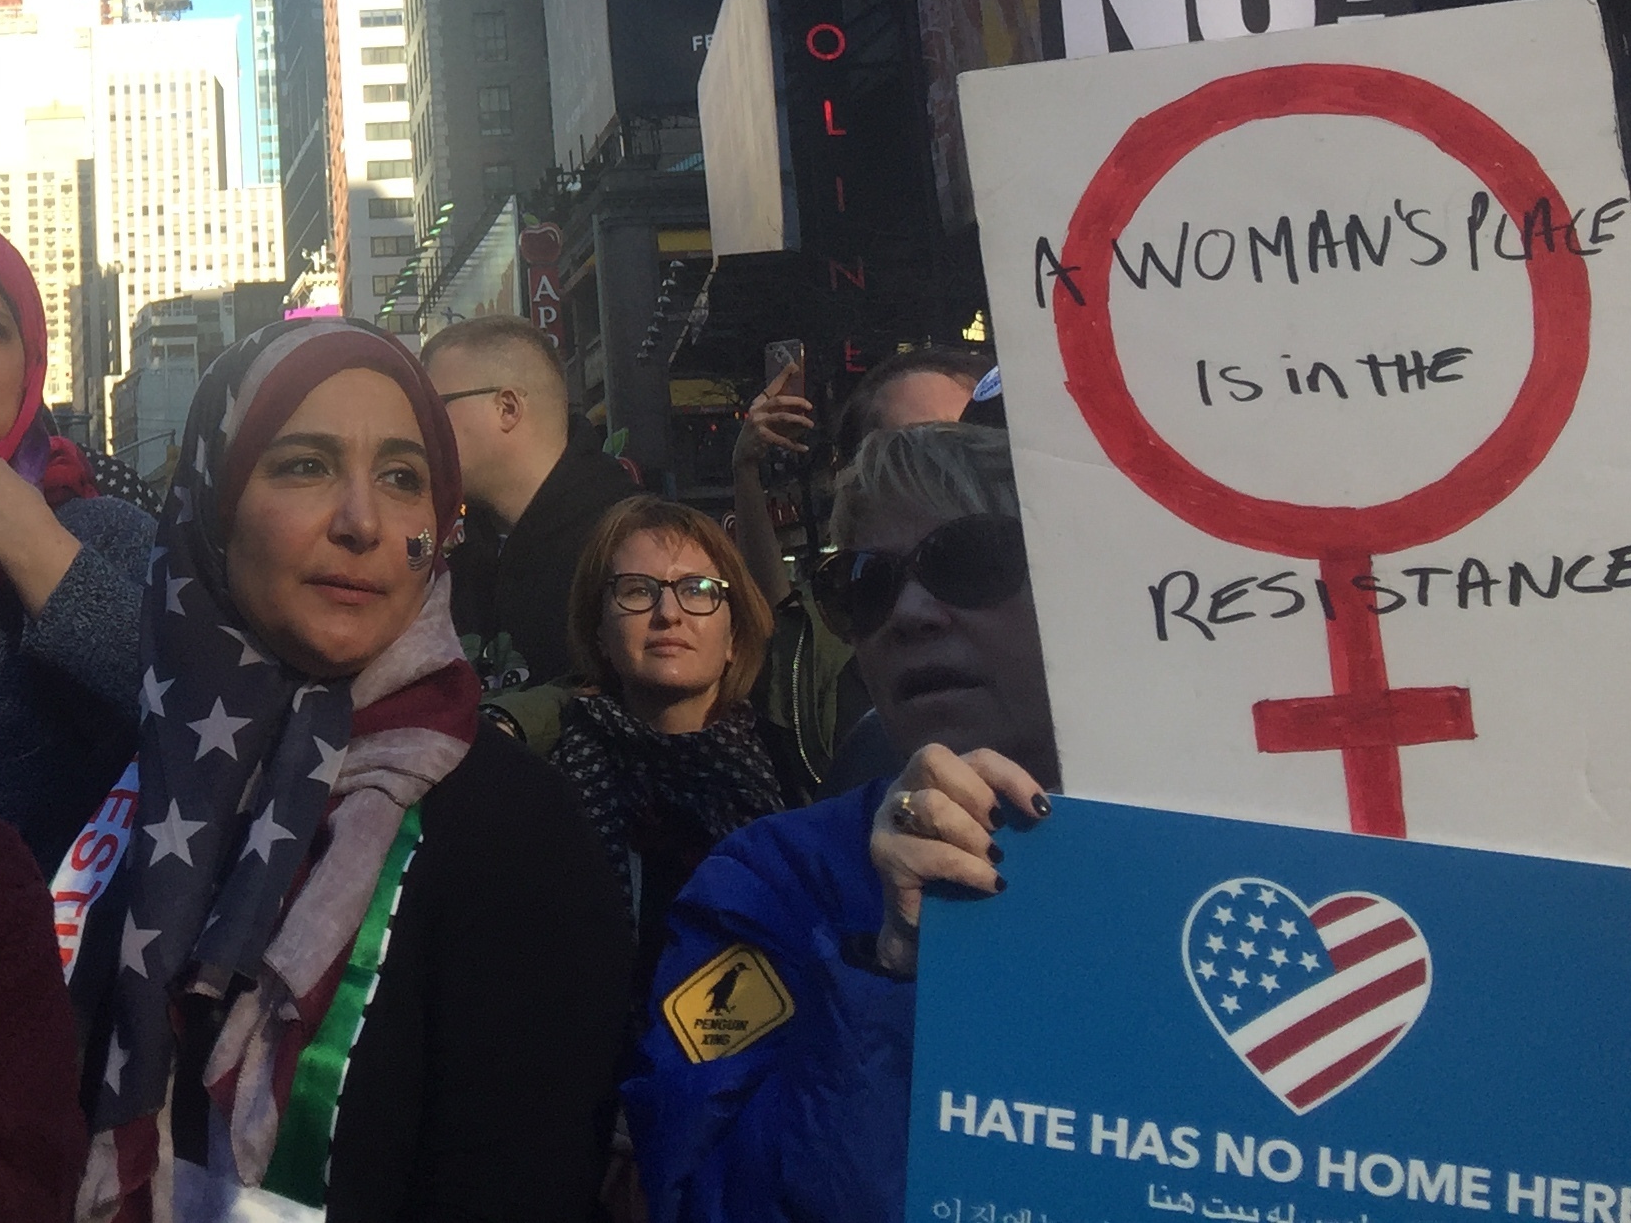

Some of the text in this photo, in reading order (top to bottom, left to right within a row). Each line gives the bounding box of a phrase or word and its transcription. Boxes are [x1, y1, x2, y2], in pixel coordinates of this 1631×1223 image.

[1034, 192, 1630, 308] A WOMAN'S PLACE
[1357, 347, 1472, 399] THE
[1148, 545, 1631, 642] RESISTANCE
[694, 1018, 749, 1032] PENGUIN
[701, 1034, 731, 1046] XING
[939, 1091, 1077, 1152] HATE
[1089, 1112, 1200, 1169] HAS
[1215, 1131, 1303, 1183] NO
[1318, 1147, 1491, 1211] HOME
